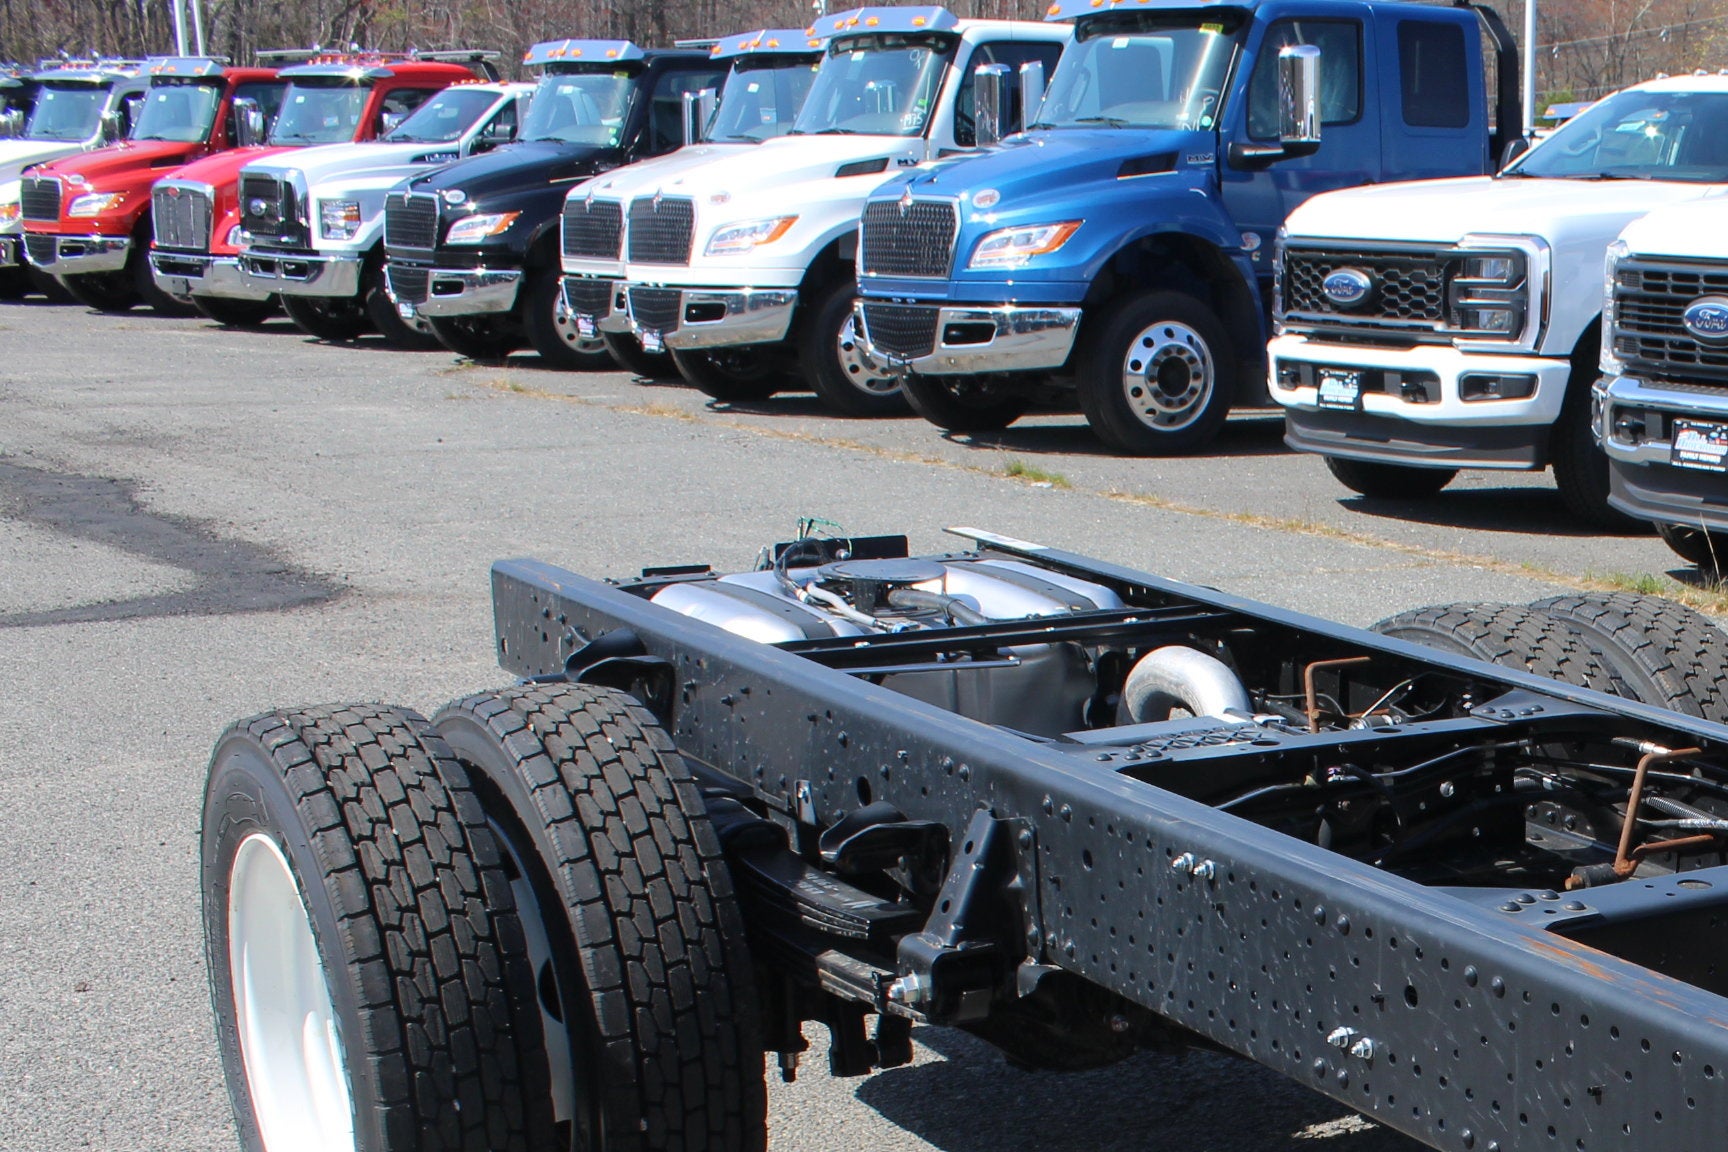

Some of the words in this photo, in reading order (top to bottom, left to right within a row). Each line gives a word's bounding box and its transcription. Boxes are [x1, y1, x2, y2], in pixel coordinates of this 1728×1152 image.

[1187, 153, 1215, 164] MV
[1331, 277, 1354, 296] Ford
[1695, 308, 1728, 330] Ford
